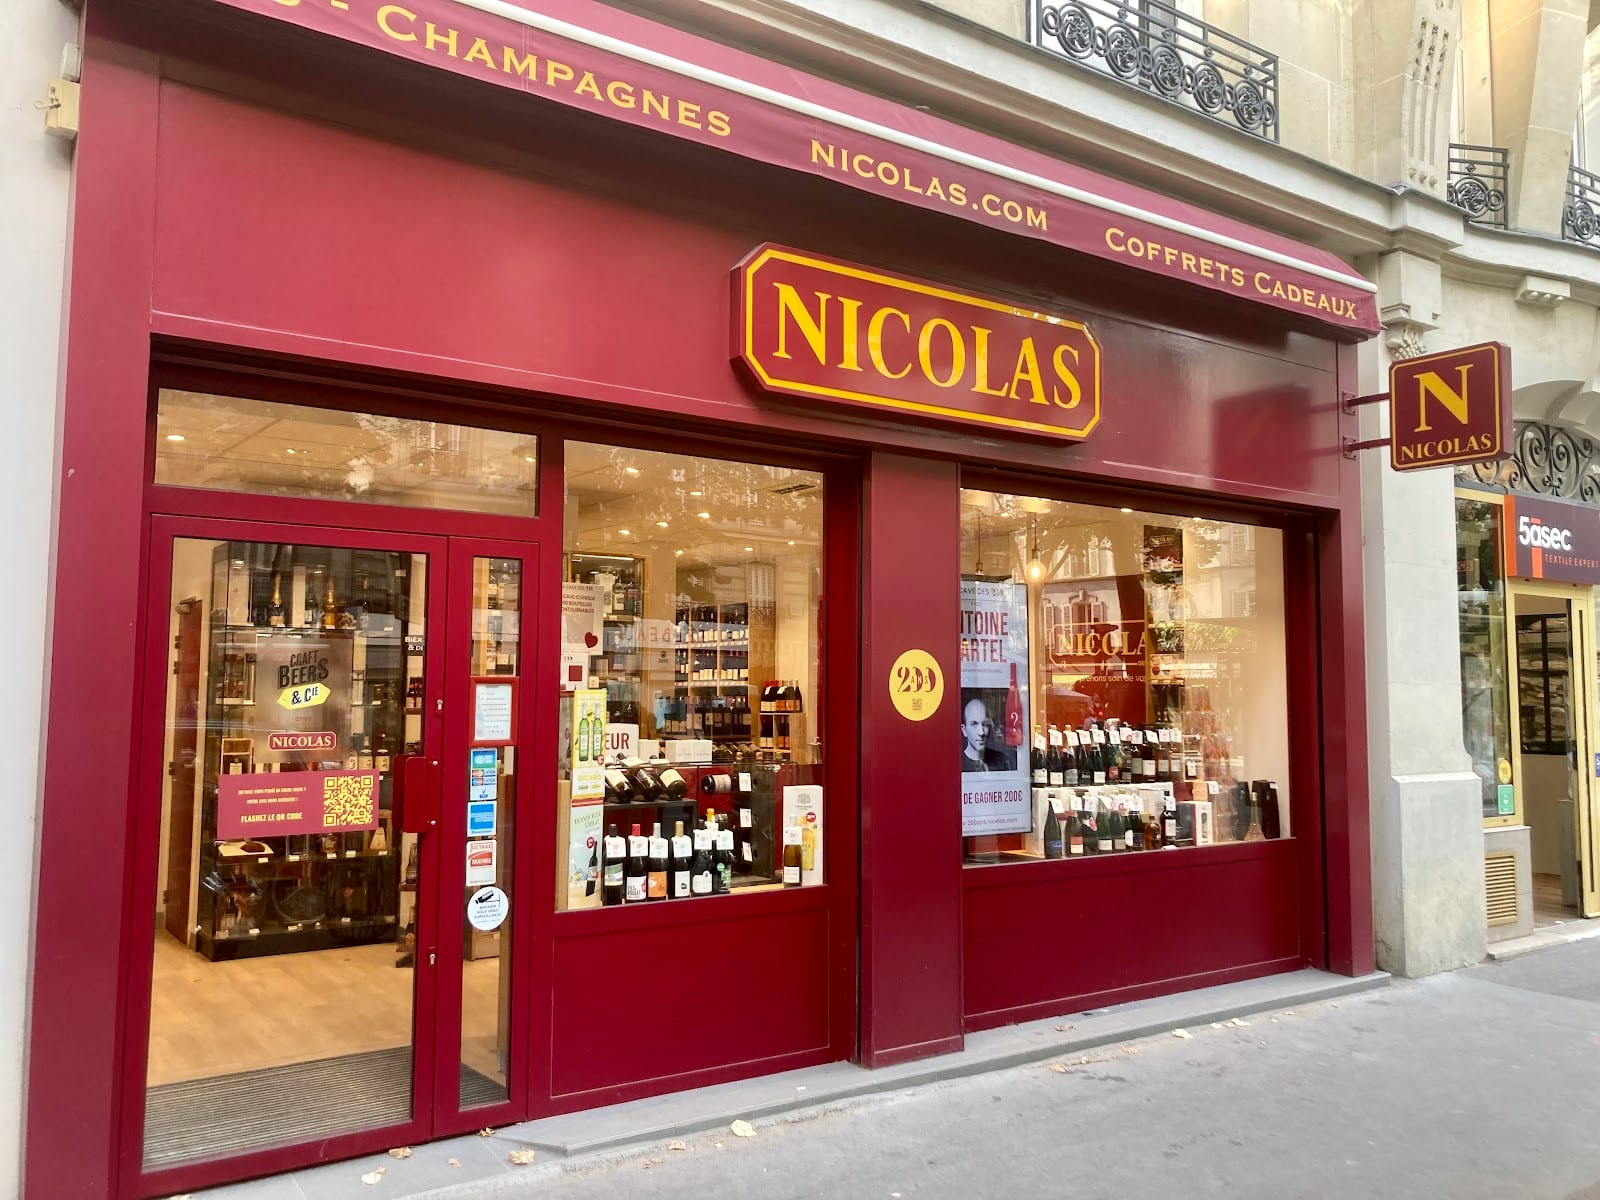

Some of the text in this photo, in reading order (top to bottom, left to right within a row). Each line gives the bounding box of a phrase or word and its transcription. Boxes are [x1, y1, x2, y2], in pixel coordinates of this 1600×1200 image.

[376, 4, 732, 137] CHAMPAGNES
[810, 140, 1049, 232] NICOLAS.COM
[1104, 227, 1358, 320] COFFRETS CADEAUX
[772, 281, 1082, 410] NICOLAS
[1413, 363, 1474, 432] N
[1401, 433, 1492, 461] NICOLAS
[1545, 554, 1573, 566] TEXTILE
[277, 657, 330, 690] BEERS
[290, 649, 320, 668] CRAFT
[291, 690, 303, 705] &
[271, 735, 332, 748] NICOLAS
[963, 792, 973, 804] DE
[974, 791, 1003, 804] GAGNER
